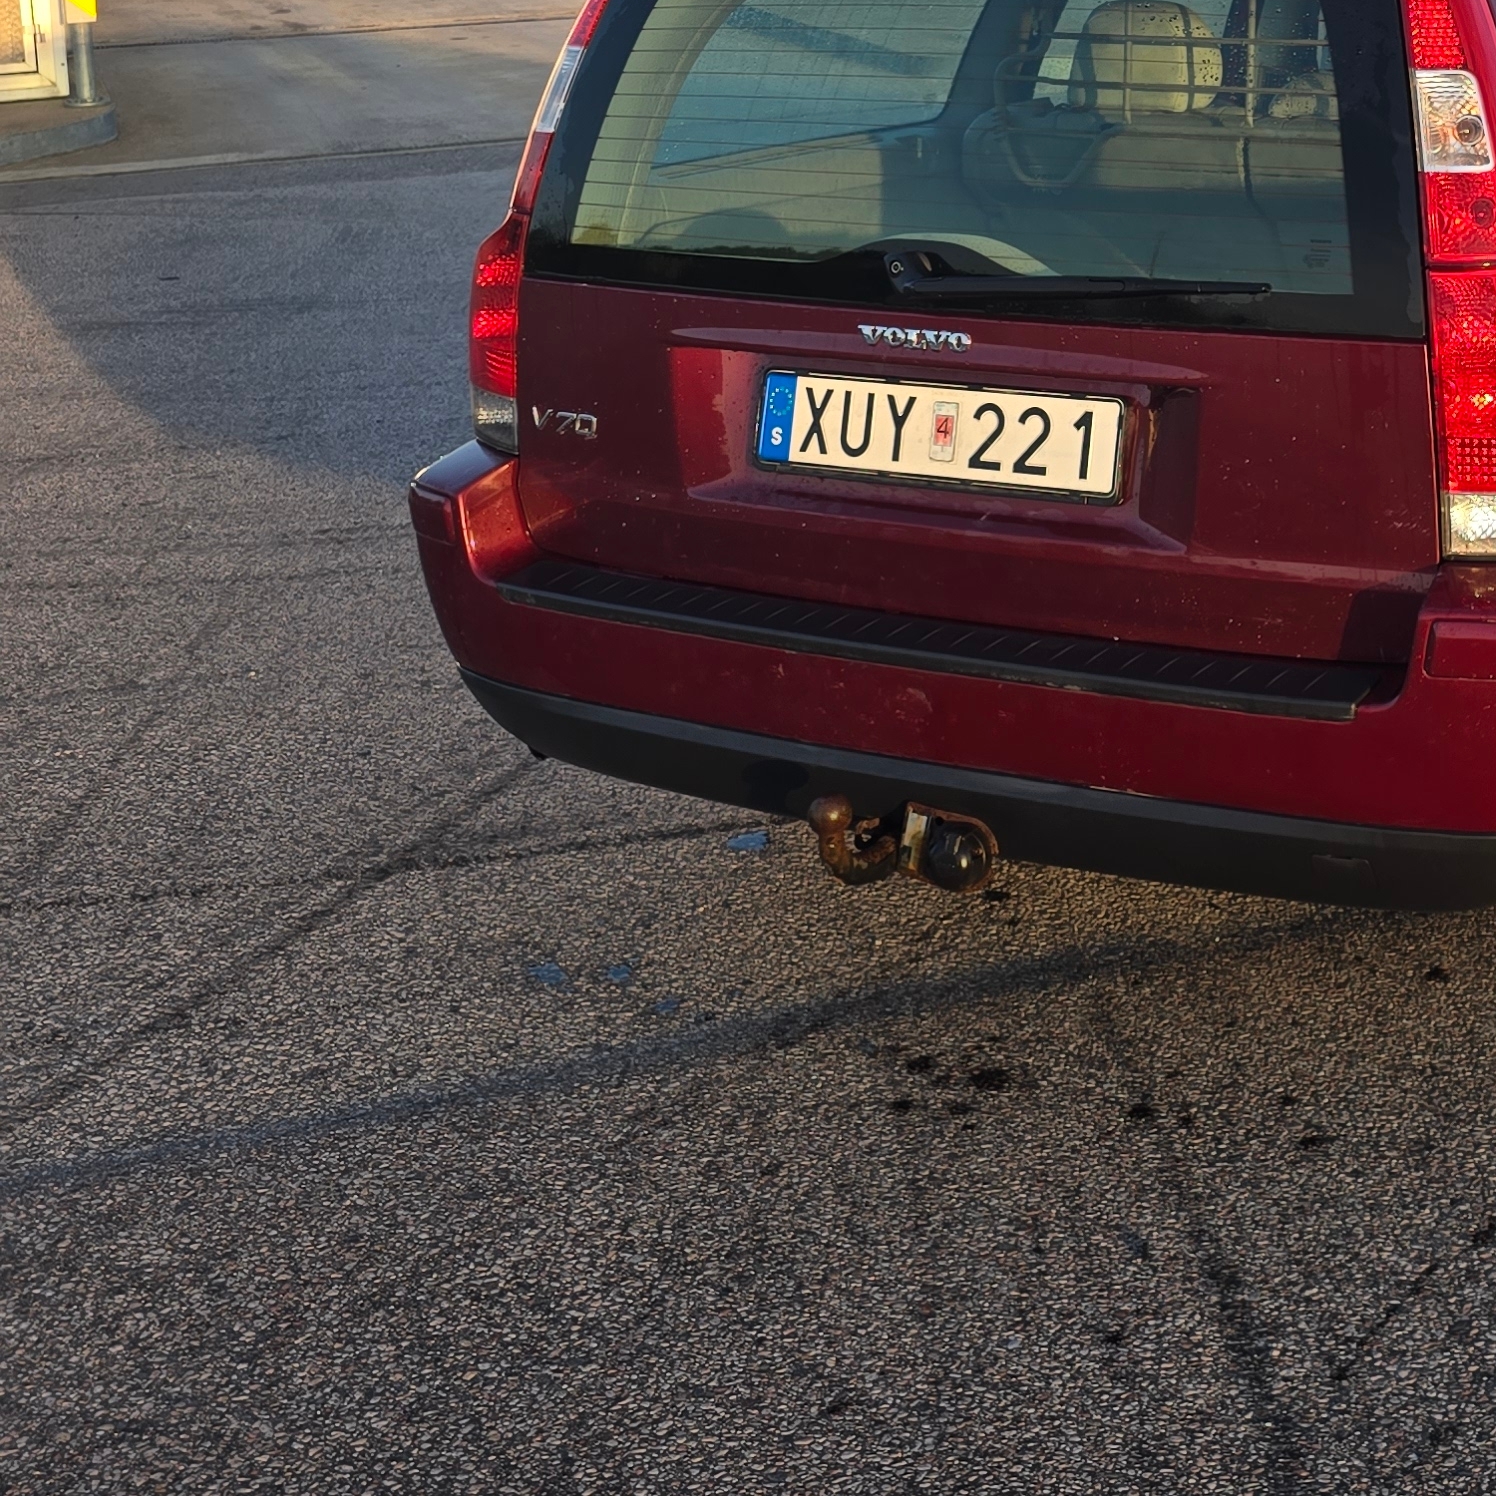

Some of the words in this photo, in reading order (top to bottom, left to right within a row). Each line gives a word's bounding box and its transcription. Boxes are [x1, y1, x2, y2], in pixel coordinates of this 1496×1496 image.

[858, 324, 972, 352] VOLVO
[532, 405, 598, 437] V70
[799, 387, 917, 462] XUY
[968, 402, 1094, 480] 221
[936, 417, 950, 439] 4
[771, 426, 783, 446] S
